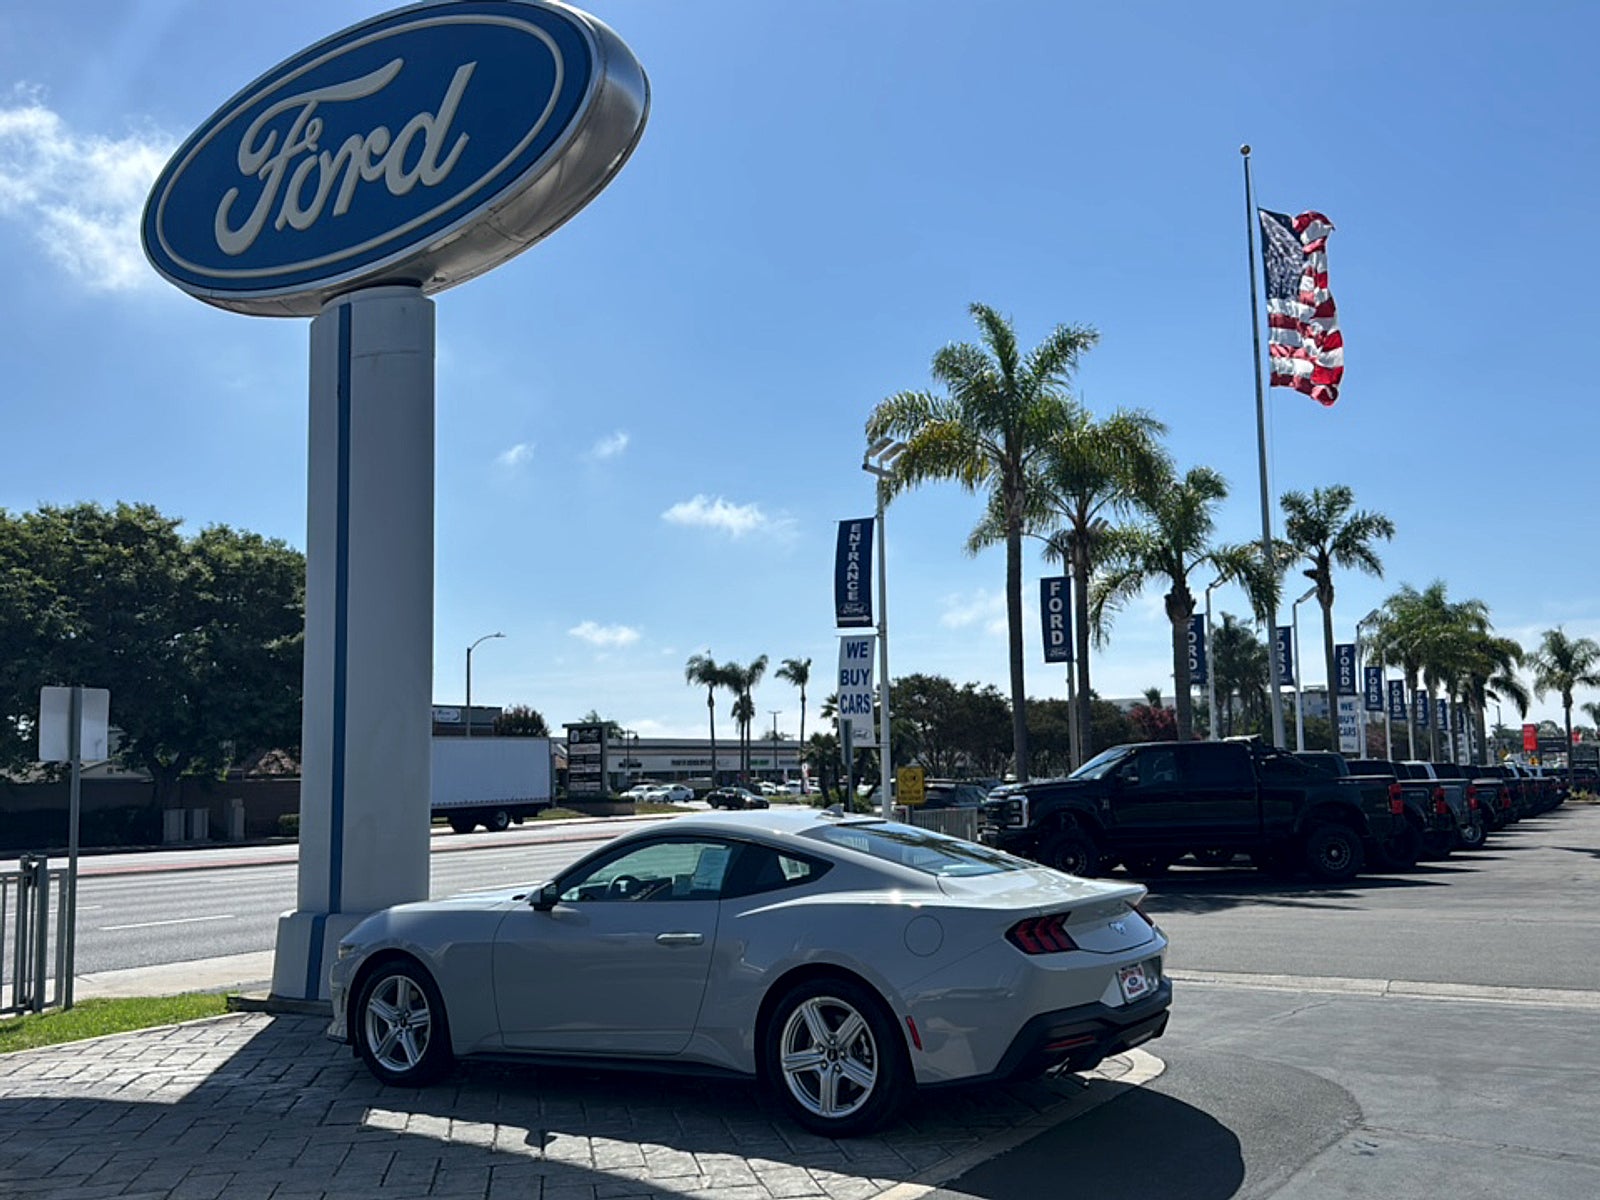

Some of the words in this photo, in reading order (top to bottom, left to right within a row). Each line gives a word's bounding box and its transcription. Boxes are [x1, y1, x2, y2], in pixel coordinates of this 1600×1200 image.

[215, 58, 477, 256] Ford
[847, 523, 861, 601] ENTRANCE
[1048, 582, 1064, 645] FORD
[847, 641, 868, 659] WE
[1340, 647, 1350, 686] FORD
[840, 669, 869, 686] BUY
[1369, 669, 1378, 703] FORD
[840, 694, 870, 714] CARS
[1392, 681, 1401, 712] FORD
